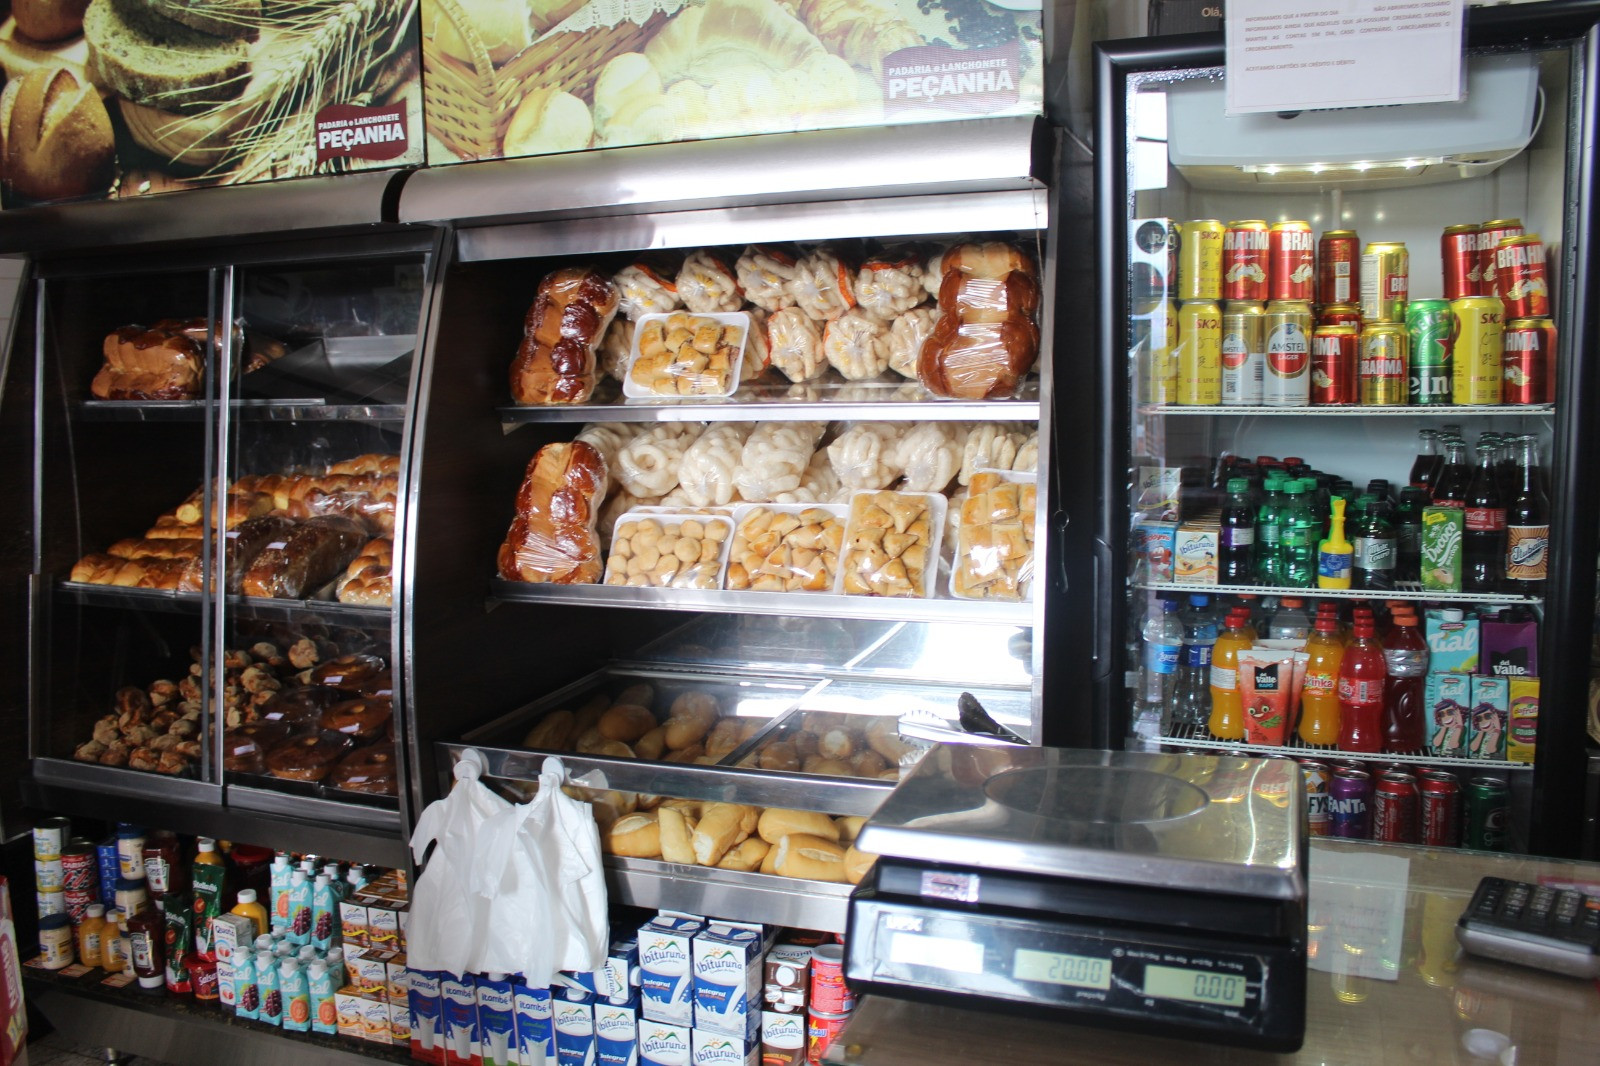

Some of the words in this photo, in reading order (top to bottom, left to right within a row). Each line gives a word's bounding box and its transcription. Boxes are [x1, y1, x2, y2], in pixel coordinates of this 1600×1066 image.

[1201, 6, 1223, 18] Olá,
[888, 64, 932, 76] PADARIA
[942, 58, 1008, 72] LANCHONETE
[888, 69, 1015, 103] PEÇANHA
[318, 119, 348, 131] PADARIA
[354, 113, 400, 126] LANCHONETE
[318, 122, 405, 152] PEÇANHA
[1271, 342, 1306, 352] AMSTEL
[1180, 541, 1215, 555] Ibituruna
[1428, 627, 1479, 653] Tial
[1492, 665, 1525, 675] Valle
[1255, 676, 1278, 684] Valle
[1328, 795, 1367, 814] FANTA
[641, 949, 687, 966] Ibituruna
[696, 959, 743, 974] Ibituruna
[1048, 955, 1104, 984] 20.00
[643, 978, 671, 989] Integral
[1194, 973, 1237, 1001] 0.00
[697, 987, 727, 997] Integral
[556, 1014, 592, 1026] Ibituruna
[597, 1019, 635, 1032] Ibituruna
[763, 1026, 803, 1039] Ibituruna
[558, 1047, 585, 1057] Integral
[641, 1040, 687, 1054] Ibituruna
[600, 1053, 627, 1062] Integral
[695, 1048, 742, 1063] Ibituruna
